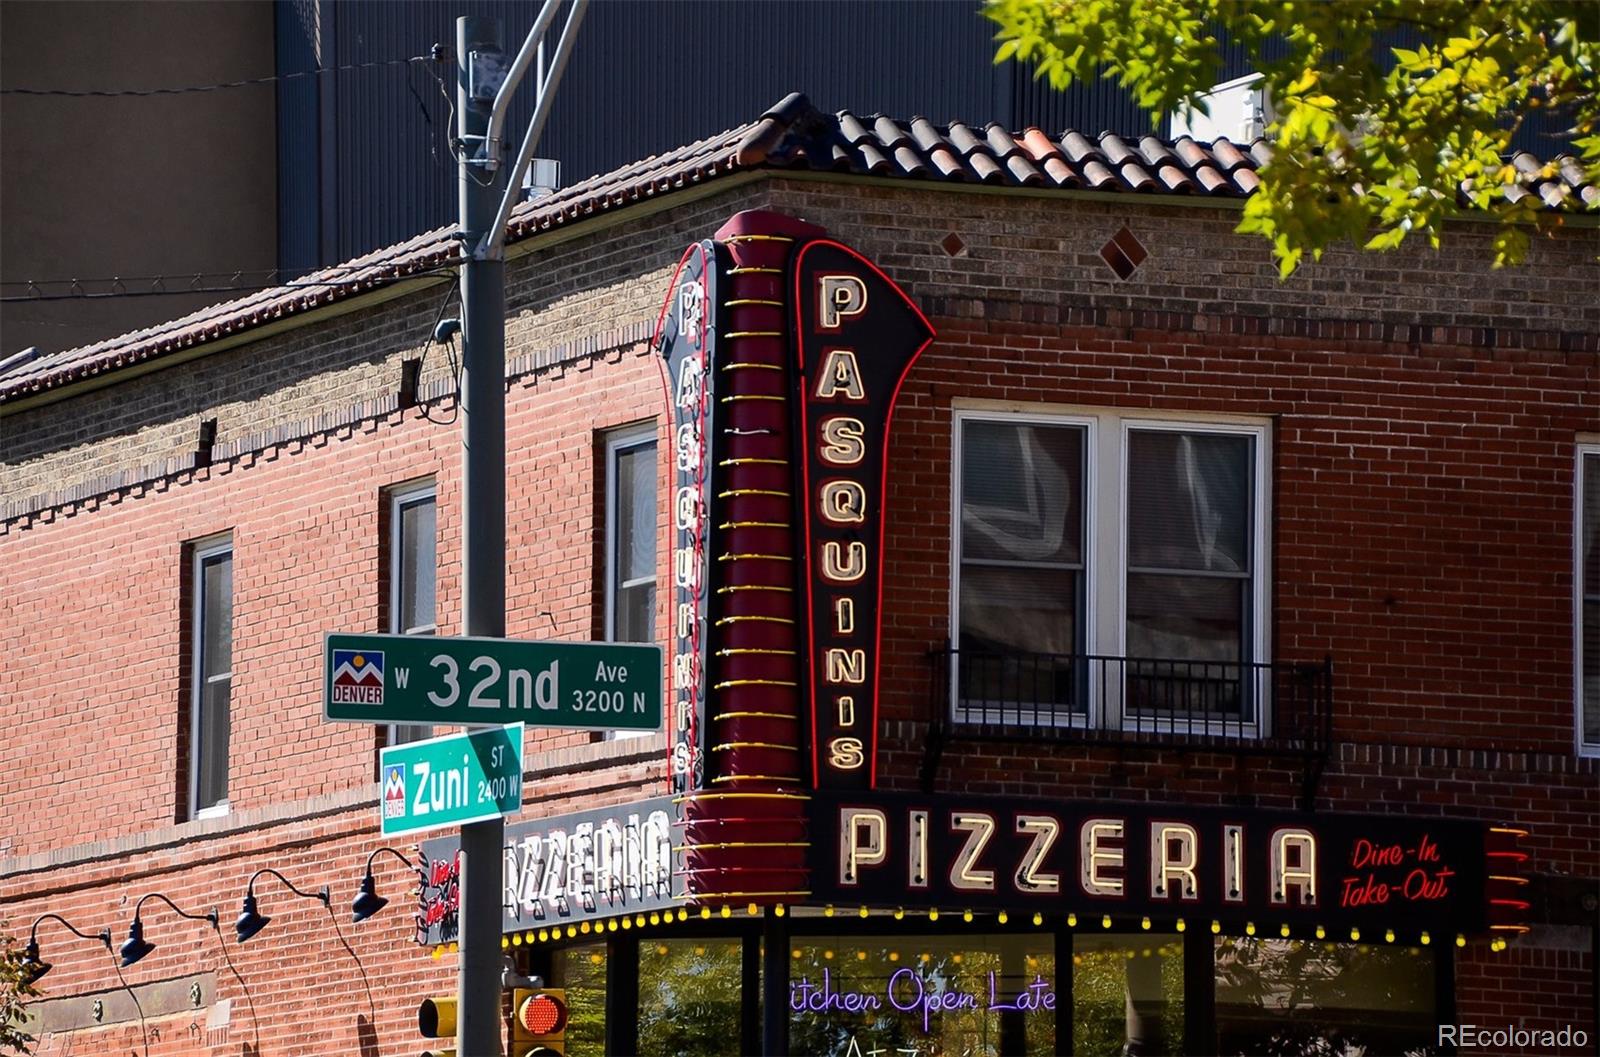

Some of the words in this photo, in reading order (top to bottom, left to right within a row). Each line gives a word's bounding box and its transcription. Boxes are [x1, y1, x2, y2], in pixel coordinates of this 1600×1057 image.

[817, 275, 868, 769] PASQUINIS
[333, 685, 383, 704] DENVER
[394, 667, 410, 689] W
[427, 654, 559, 710] 32nd
[595, 661, 628, 683] Ave
[572, 690, 624, 713] 3200
[633, 692, 646, 713] N
[413, 754, 469, 816] Zuni
[491, 745, 504, 768] ST
[477, 776, 506, 804] 2400
[509, 774, 519, 797] W
[840, 808, 1316, 905] PIZZERIA
[1353, 834, 1440, 868] Dine-In
[1342, 866, 1456, 907] Take-Out
[790, 967, 881, 1011] itchen
[888, 968, 978, 1032] Open
[988, 970, 1056, 1011] Late
